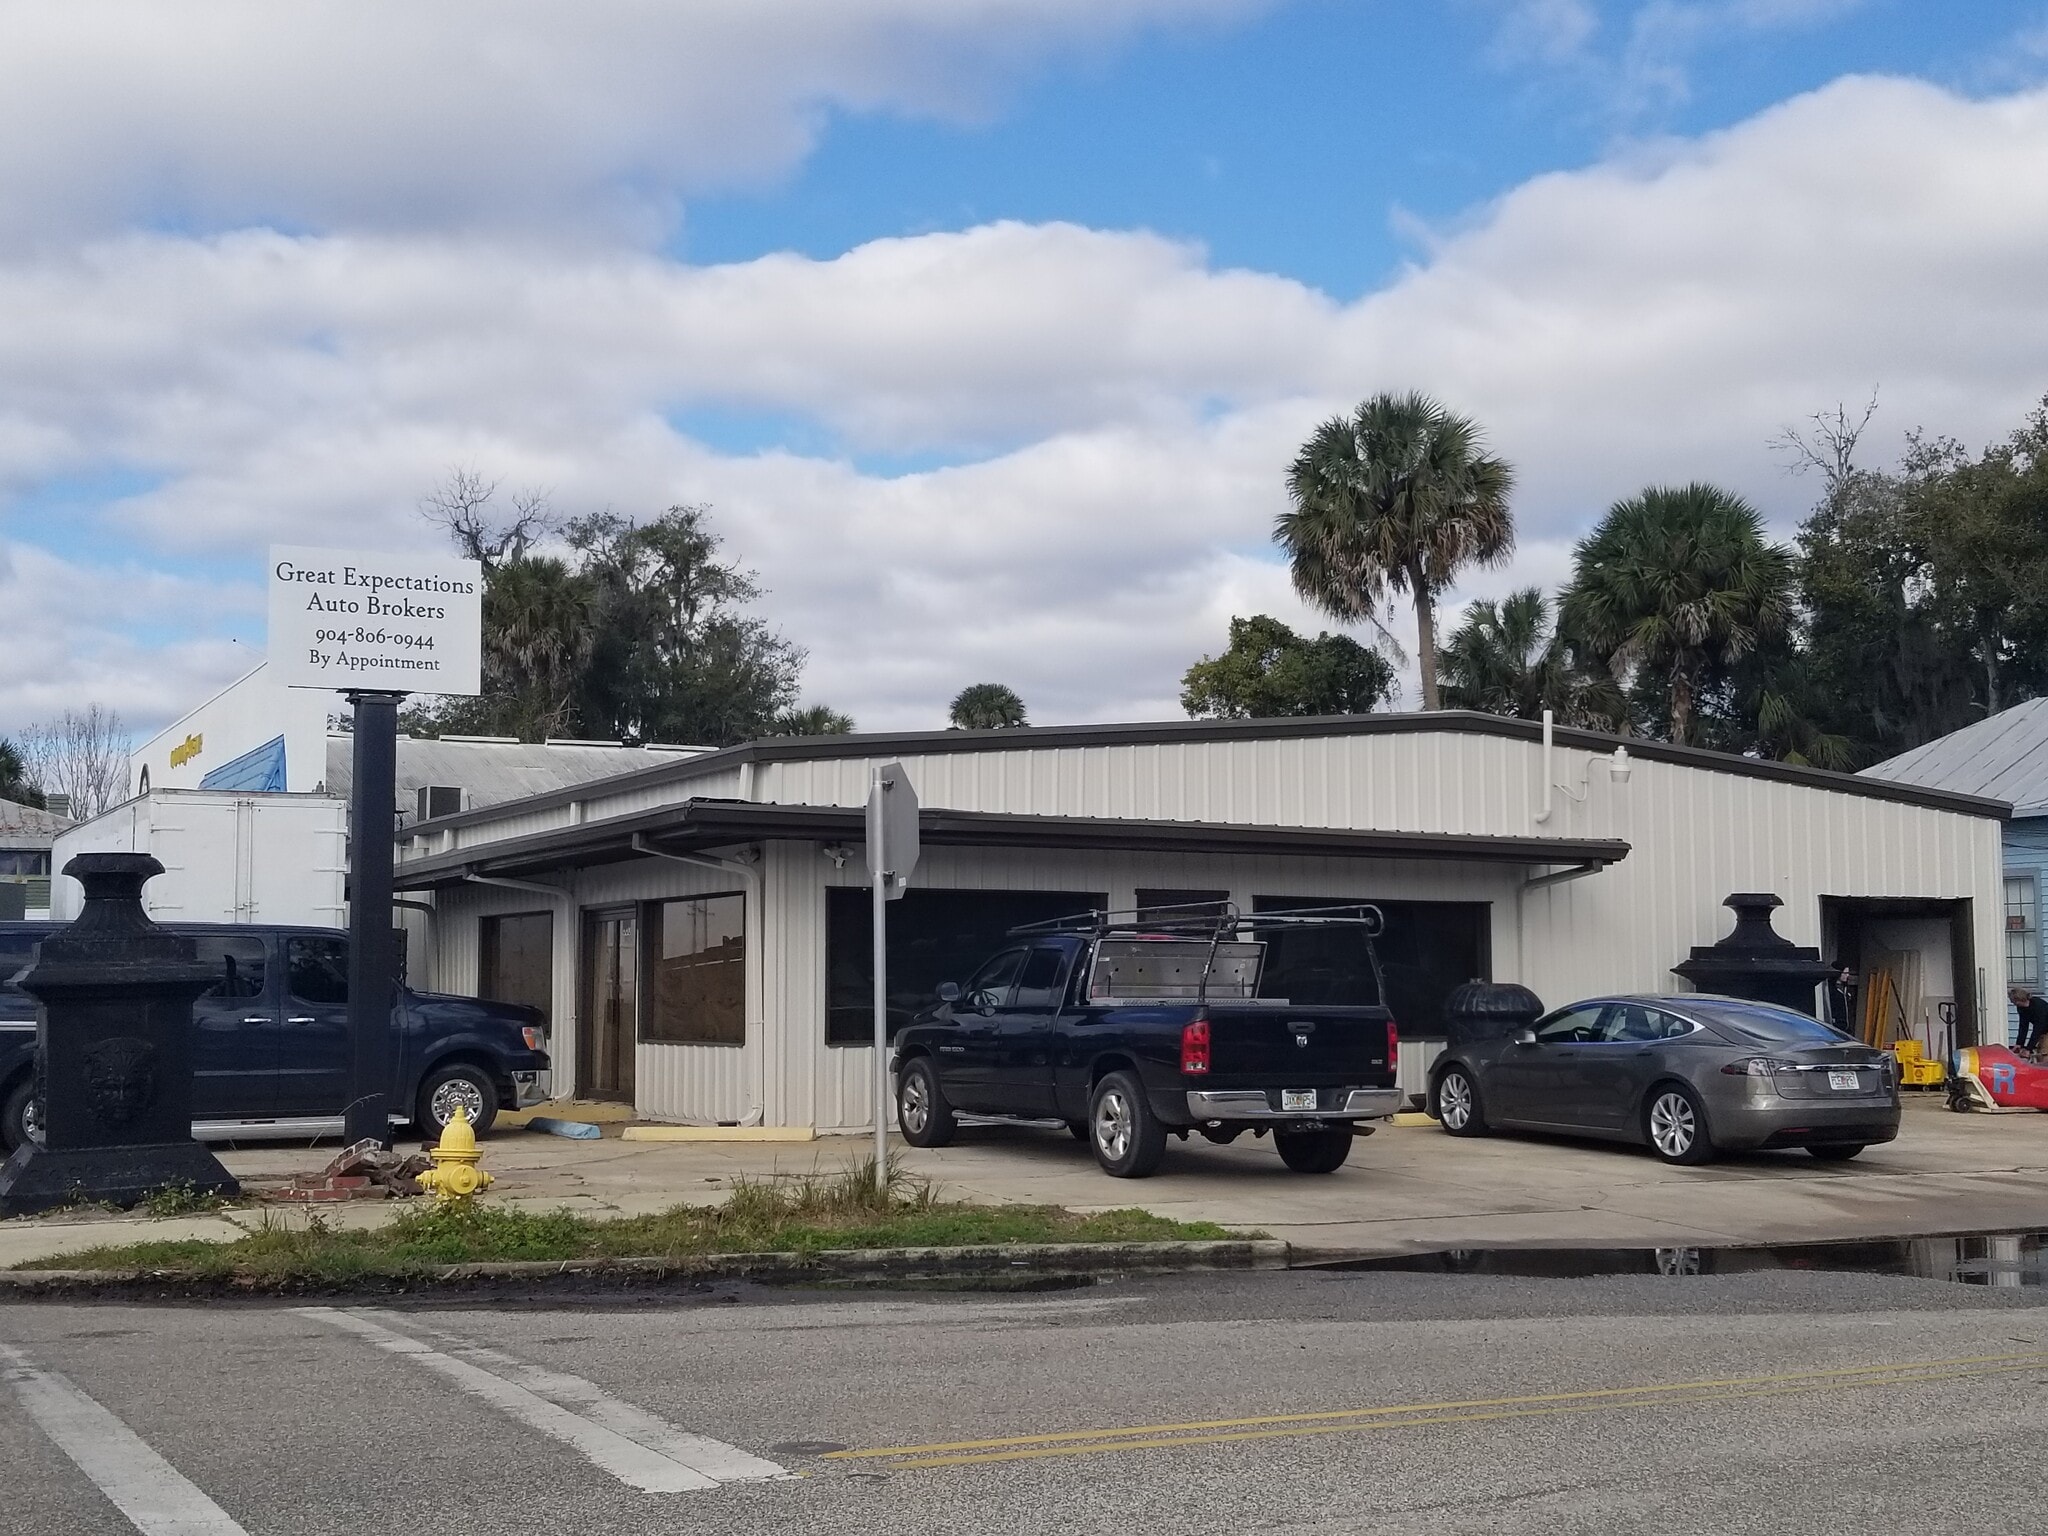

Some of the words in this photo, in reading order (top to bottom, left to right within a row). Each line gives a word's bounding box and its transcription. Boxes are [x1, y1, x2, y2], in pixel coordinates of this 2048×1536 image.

[276, 561, 336, 585] Great
[343, 566, 474, 594] Expectations
[306, 592, 359, 613] Auto
[367, 596, 445, 619] Brokers
[315, 626, 435, 650] 904-806-0944
[309, 649, 331, 669] By
[336, 651, 440, 671] Appointment
[1993, 1063, 2017, 1094] R
